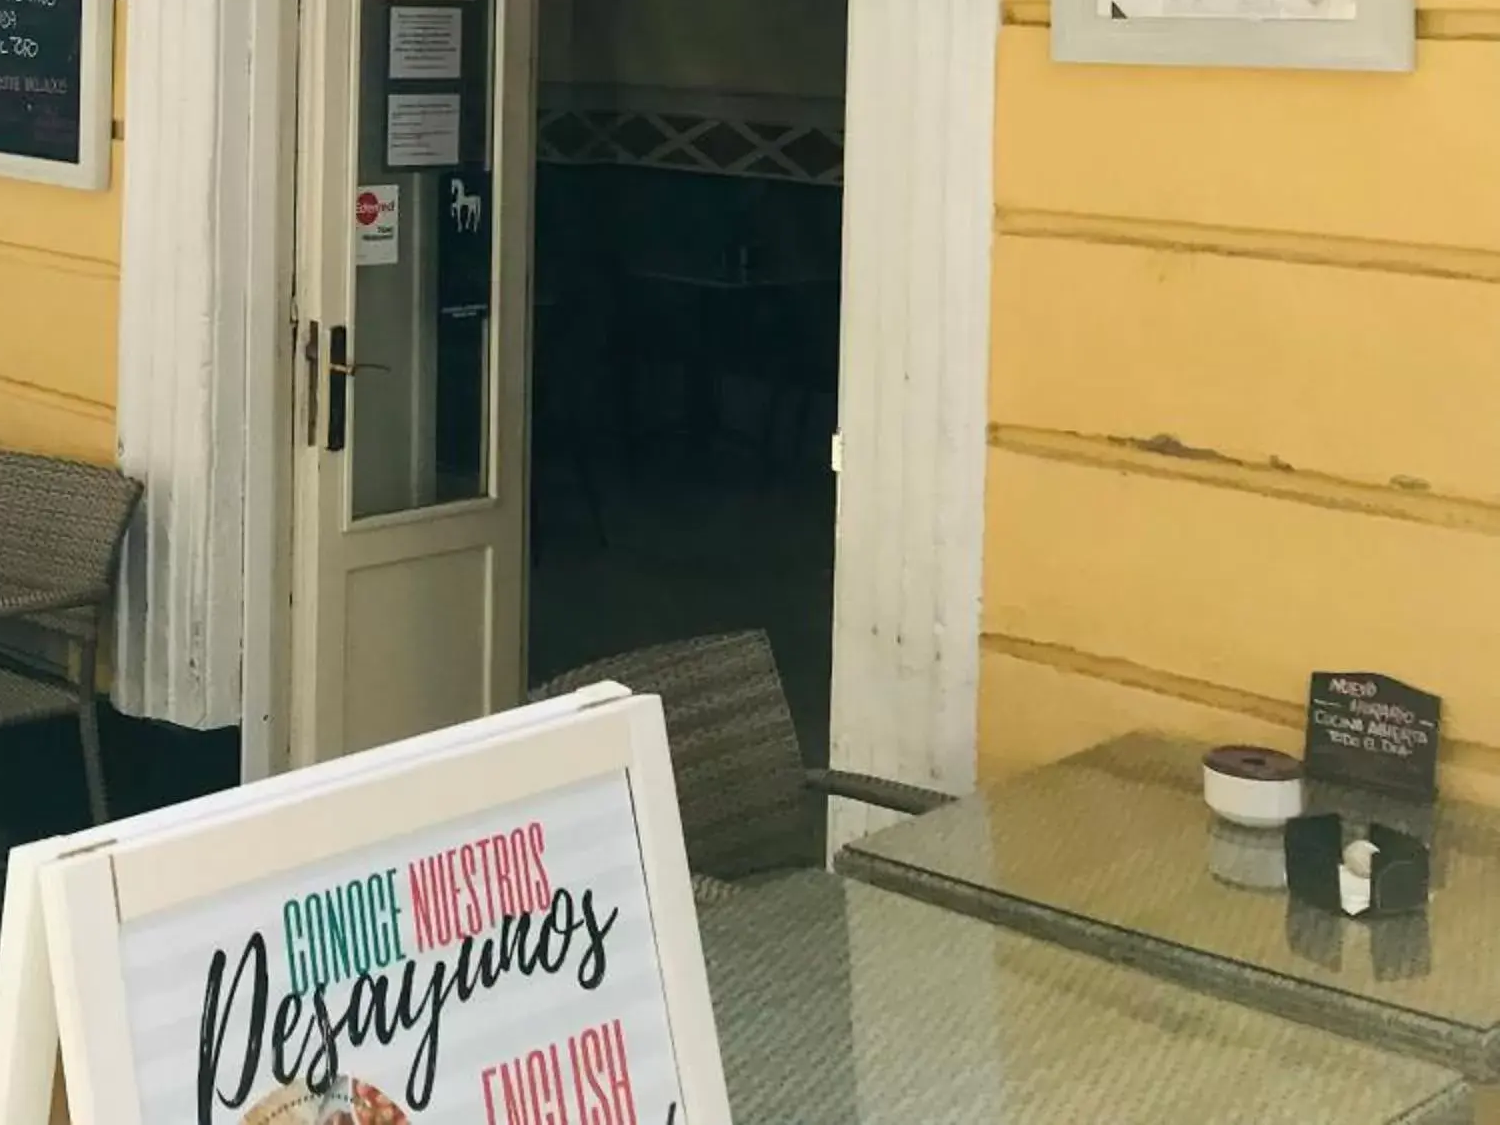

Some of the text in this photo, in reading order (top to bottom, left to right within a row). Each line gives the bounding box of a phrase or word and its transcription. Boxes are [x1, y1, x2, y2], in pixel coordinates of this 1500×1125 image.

[197, 887, 618, 1125] Desayunos
[283, 821, 553, 996] CONOCE NUESTROS
